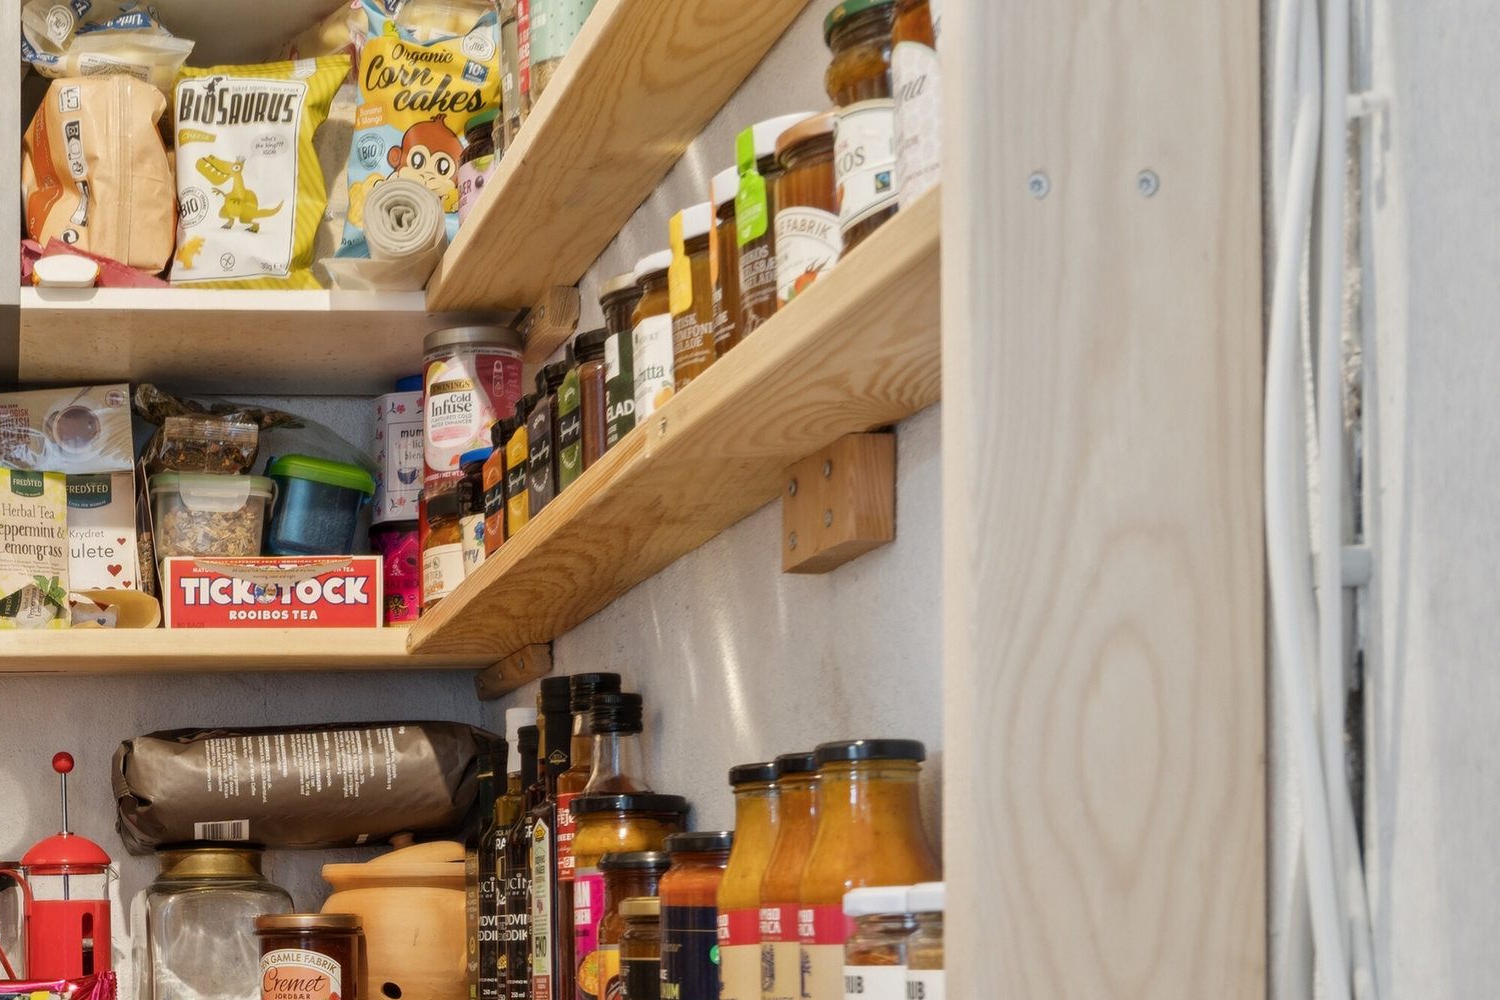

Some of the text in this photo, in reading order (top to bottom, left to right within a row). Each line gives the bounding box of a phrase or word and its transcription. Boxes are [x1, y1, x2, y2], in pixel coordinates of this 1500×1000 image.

[391, 44, 453, 65] Organic
[366, 54, 435, 92] Corn
[393, 74, 487, 113] cakes
[362, 115, 384, 126] Mango
[361, 144, 377, 158] BIO
[450, 393, 472, 404] Cold
[431, 398, 473, 418] Infuse
[13, 478, 43, 488] FREDSTED
[1, 502, 56, 520] Herbal Tea
[56, 528, 66, 540] &
[69, 529, 105, 539] Krydret
[180, 576, 256, 606] TICK
[277, 576, 370, 606] TOCK
[229, 609, 319, 621] ROOIBOS TEA
[268, 953, 337, 974] GAMLE FABRIK
[262, 964, 328, 993] Cremet
[274, 991, 311, 1000] JORDBÆR
